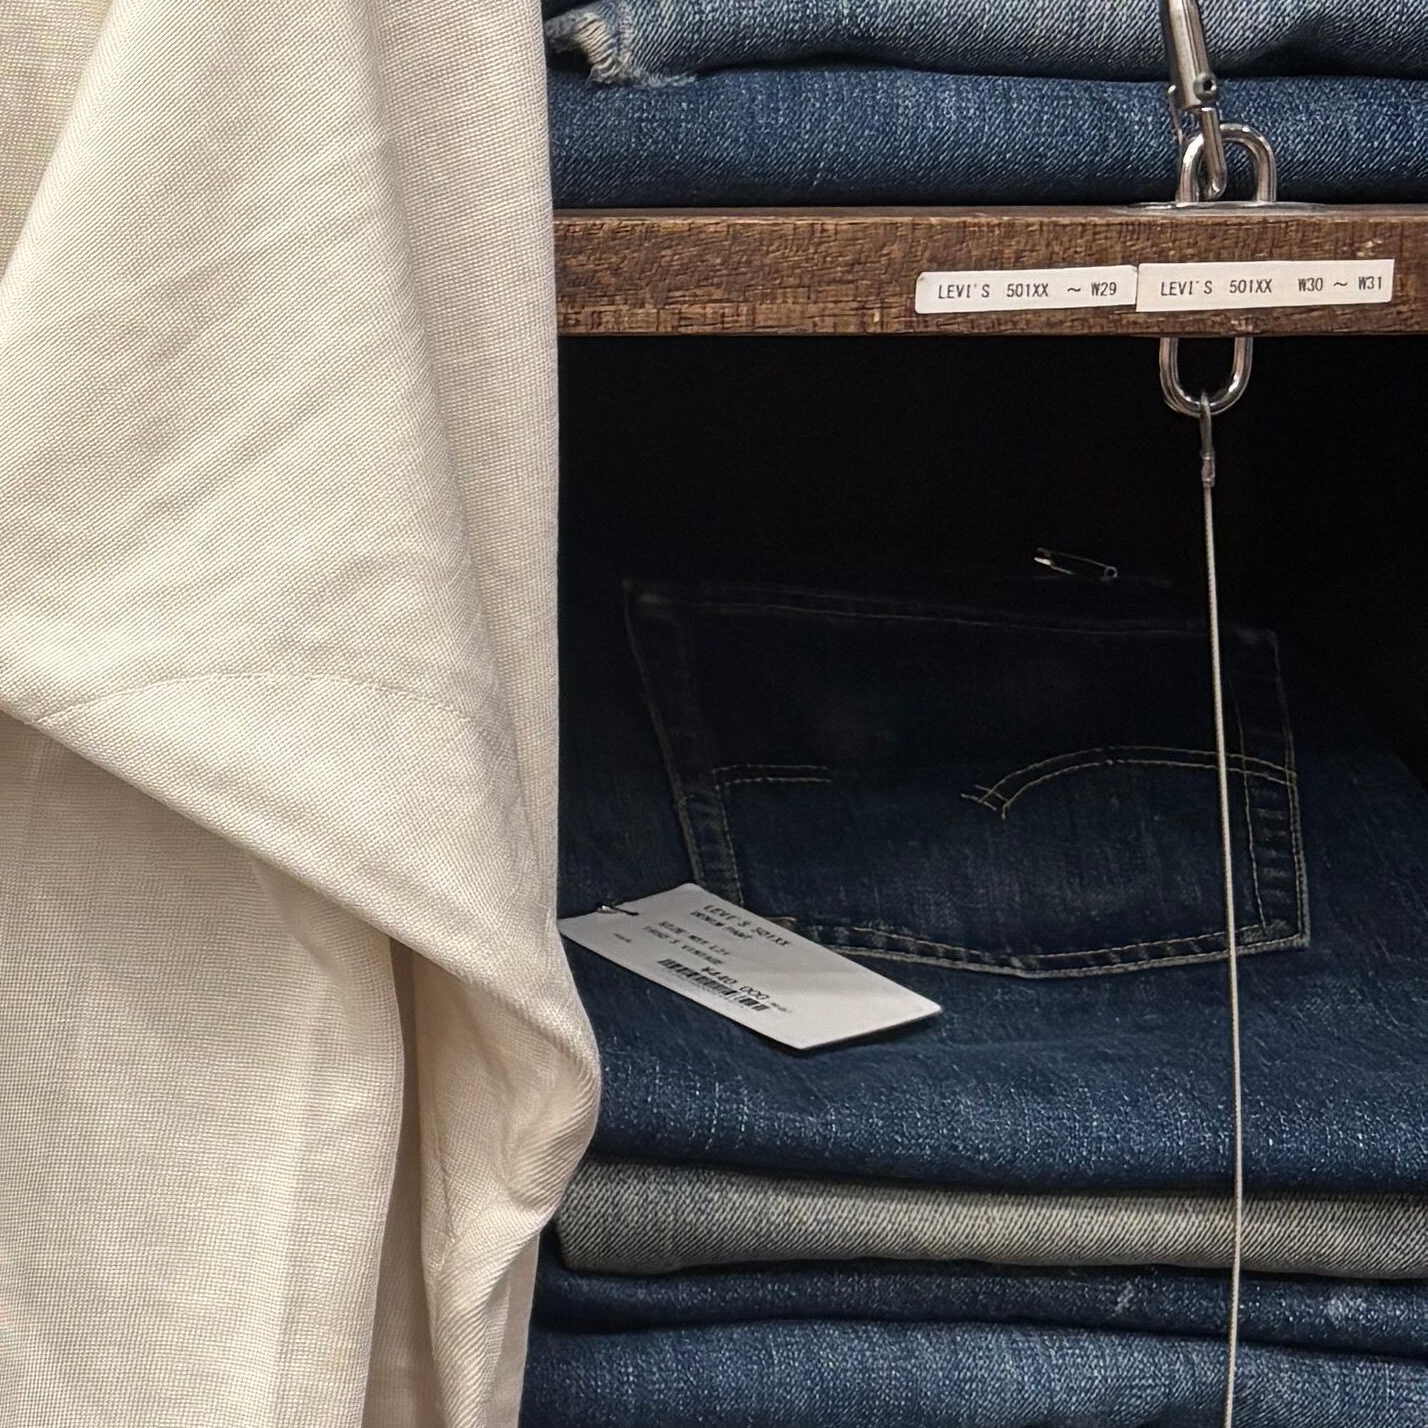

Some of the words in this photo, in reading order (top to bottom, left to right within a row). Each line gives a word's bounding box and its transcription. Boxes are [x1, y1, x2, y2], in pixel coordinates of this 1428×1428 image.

[937, 283, 991, 300] LEVI'S
[1006, 282, 1049, 298] 501XX
[1090, 281, 1118, 297] W29
[1160, 279, 1213, 296] LEVI'S
[1229, 278, 1273, 294] 501XX
[1297, 276, 1324, 292] W30
[1357, 275, 1383, 291] W31
